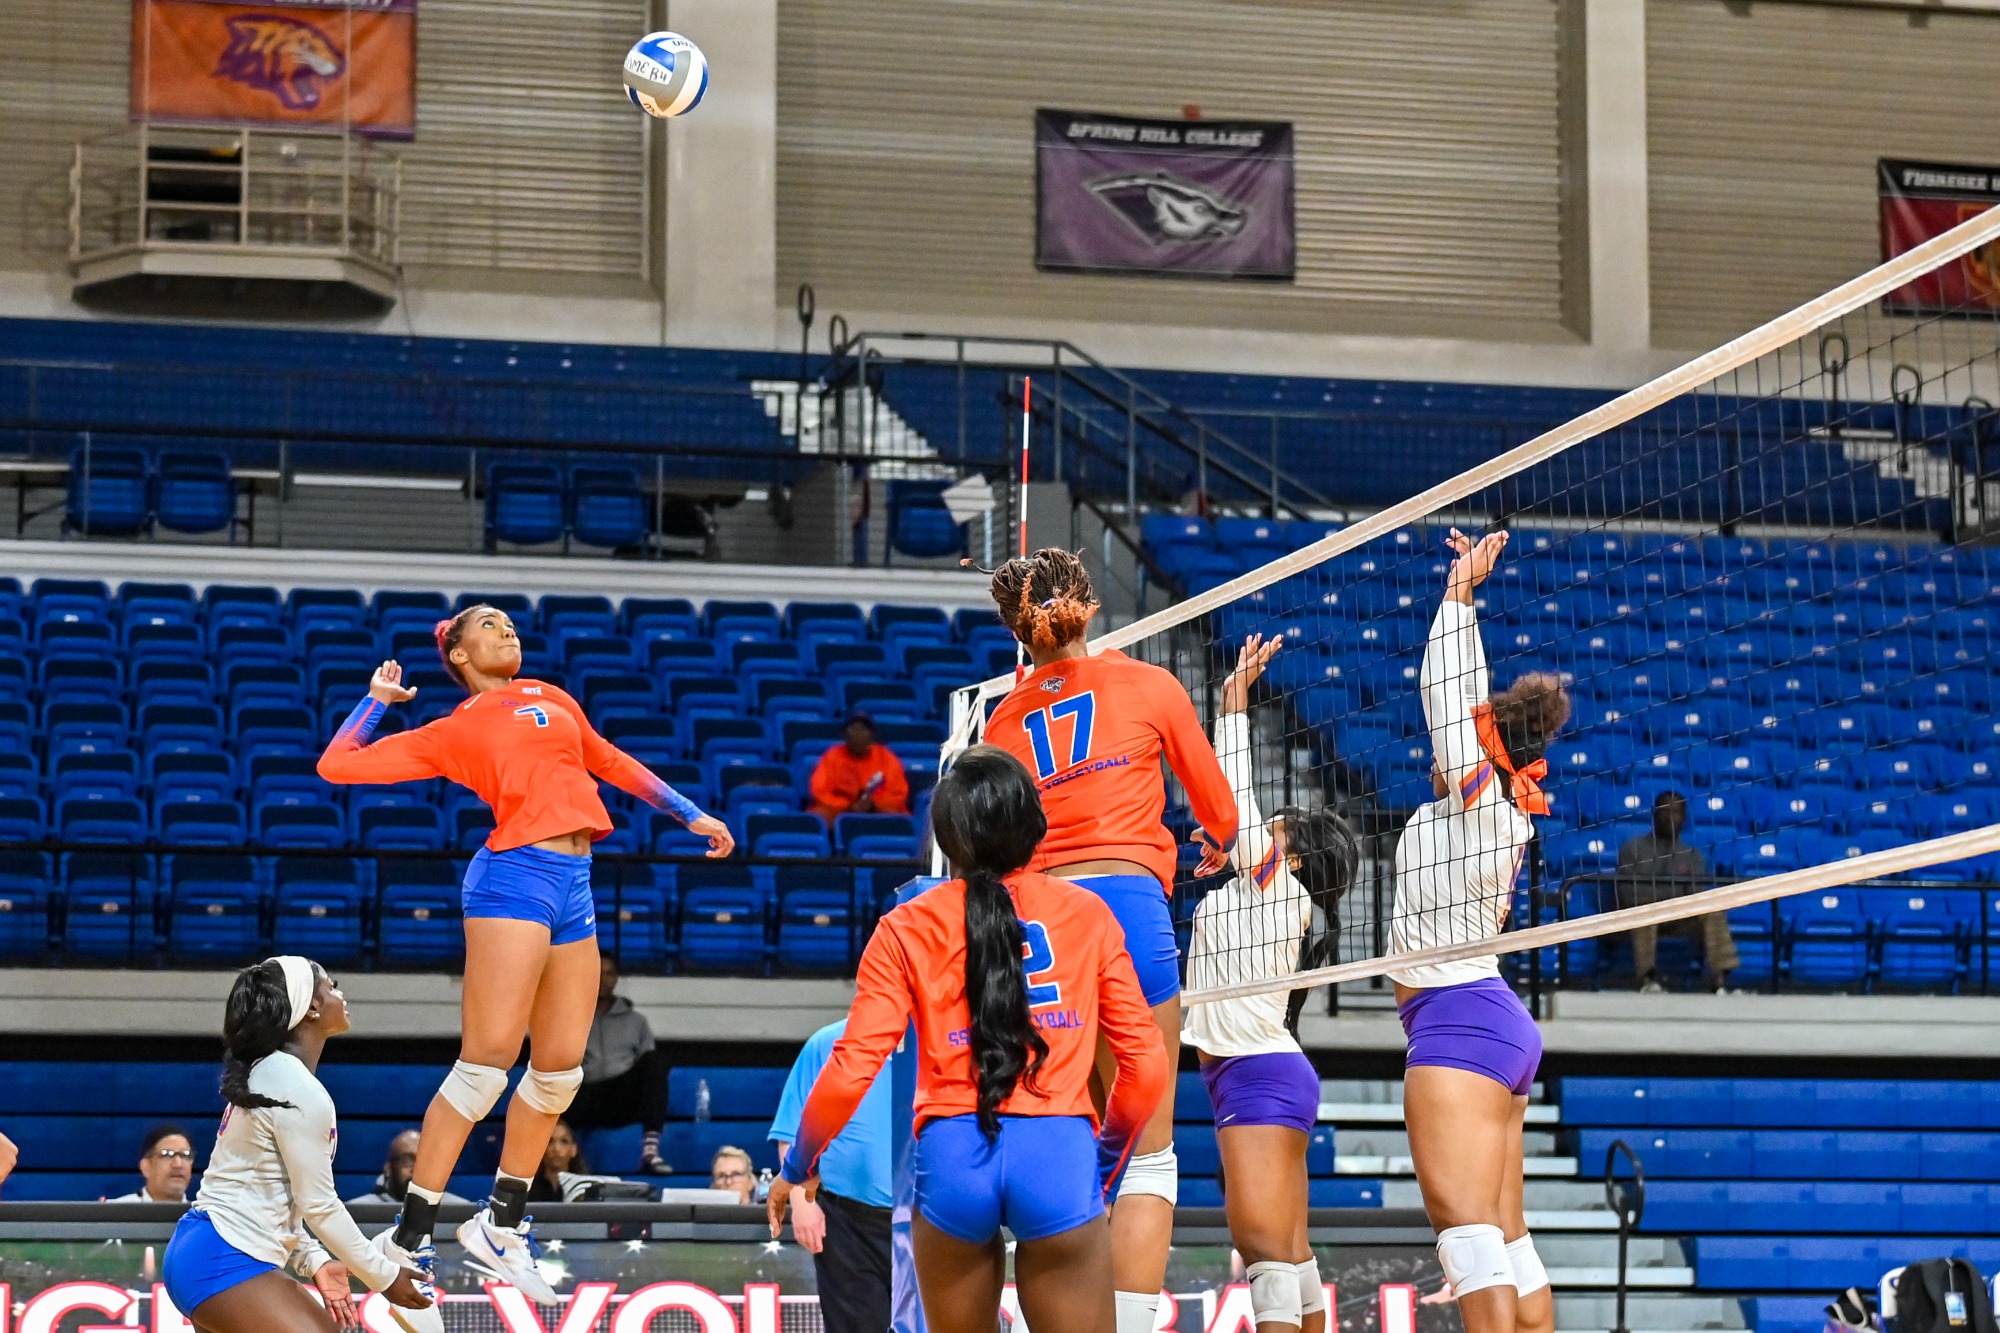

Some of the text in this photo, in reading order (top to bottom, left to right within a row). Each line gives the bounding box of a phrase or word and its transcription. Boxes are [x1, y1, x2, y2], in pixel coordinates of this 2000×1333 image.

[1067, 122, 1264, 147] SPRING HILL COLLEGE
[512, 706, 549, 728] 7
[1022, 690, 1096, 781] 17
[1017, 920, 1062, 1009] 2
